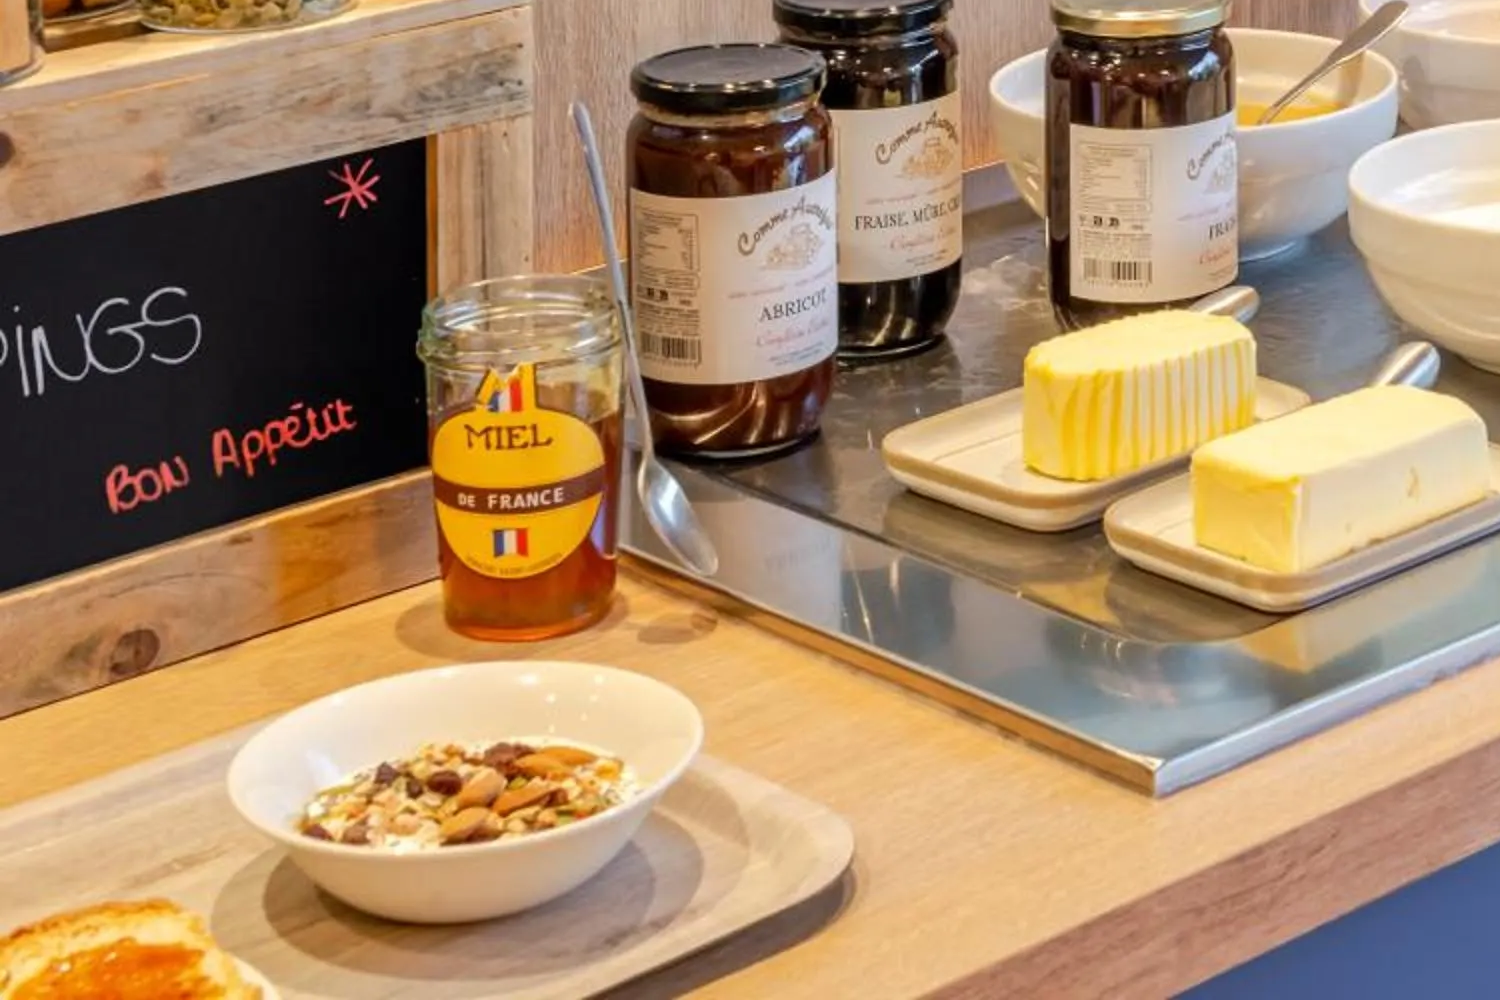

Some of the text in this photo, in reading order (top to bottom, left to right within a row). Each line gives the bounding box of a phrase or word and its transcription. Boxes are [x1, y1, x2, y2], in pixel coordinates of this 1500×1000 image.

[737, 208, 789, 256] Comme
[758, 288, 828, 323] ABRICOT
[211, 398, 357, 478] Appétit
[464, 423, 553, 451] MIEL
[458, 486, 565, 511] DE FRANCE
